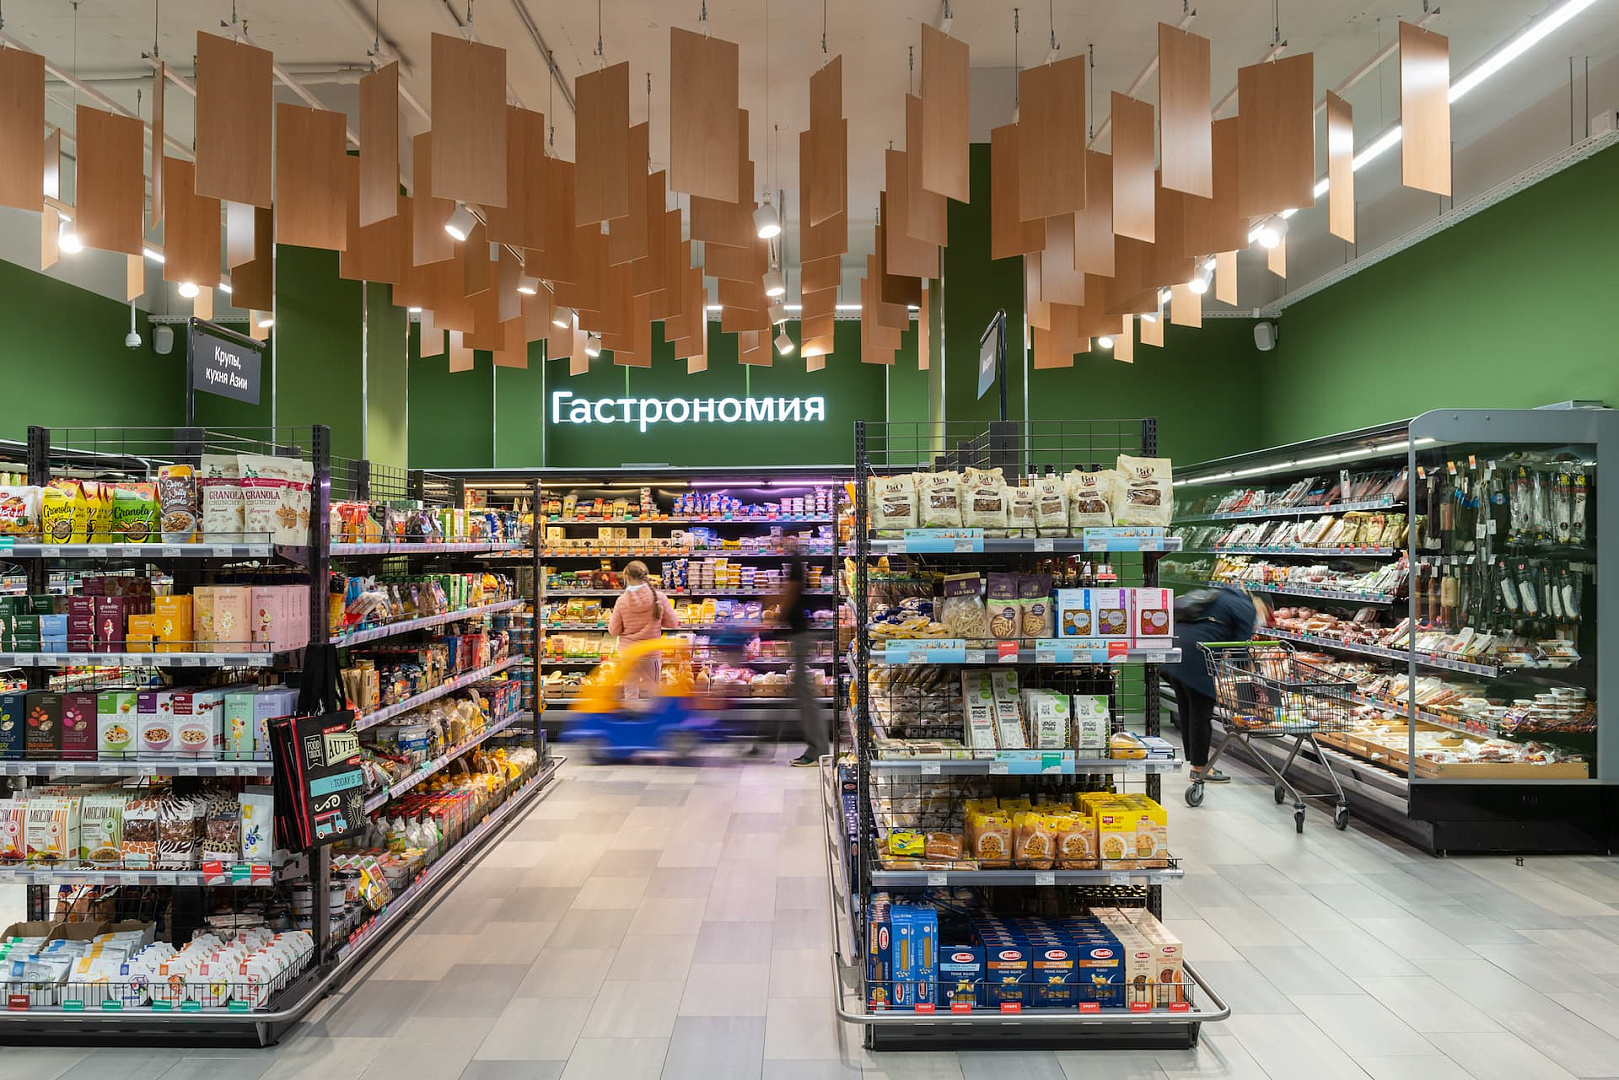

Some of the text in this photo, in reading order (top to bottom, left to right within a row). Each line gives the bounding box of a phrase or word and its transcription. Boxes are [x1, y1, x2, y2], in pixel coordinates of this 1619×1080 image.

[215, 346, 241, 370] Крупы,
[206, 368, 248, 390] кухня Азии
[553, 391, 826, 433] Гастрономия
[209, 490, 244, 500] GRANOLA
[245, 490, 281, 500] GRANOLA
[43, 502, 73, 518] Granola
[114, 503, 150, 519] Granola
[307, 740, 320, 751] FOOD
